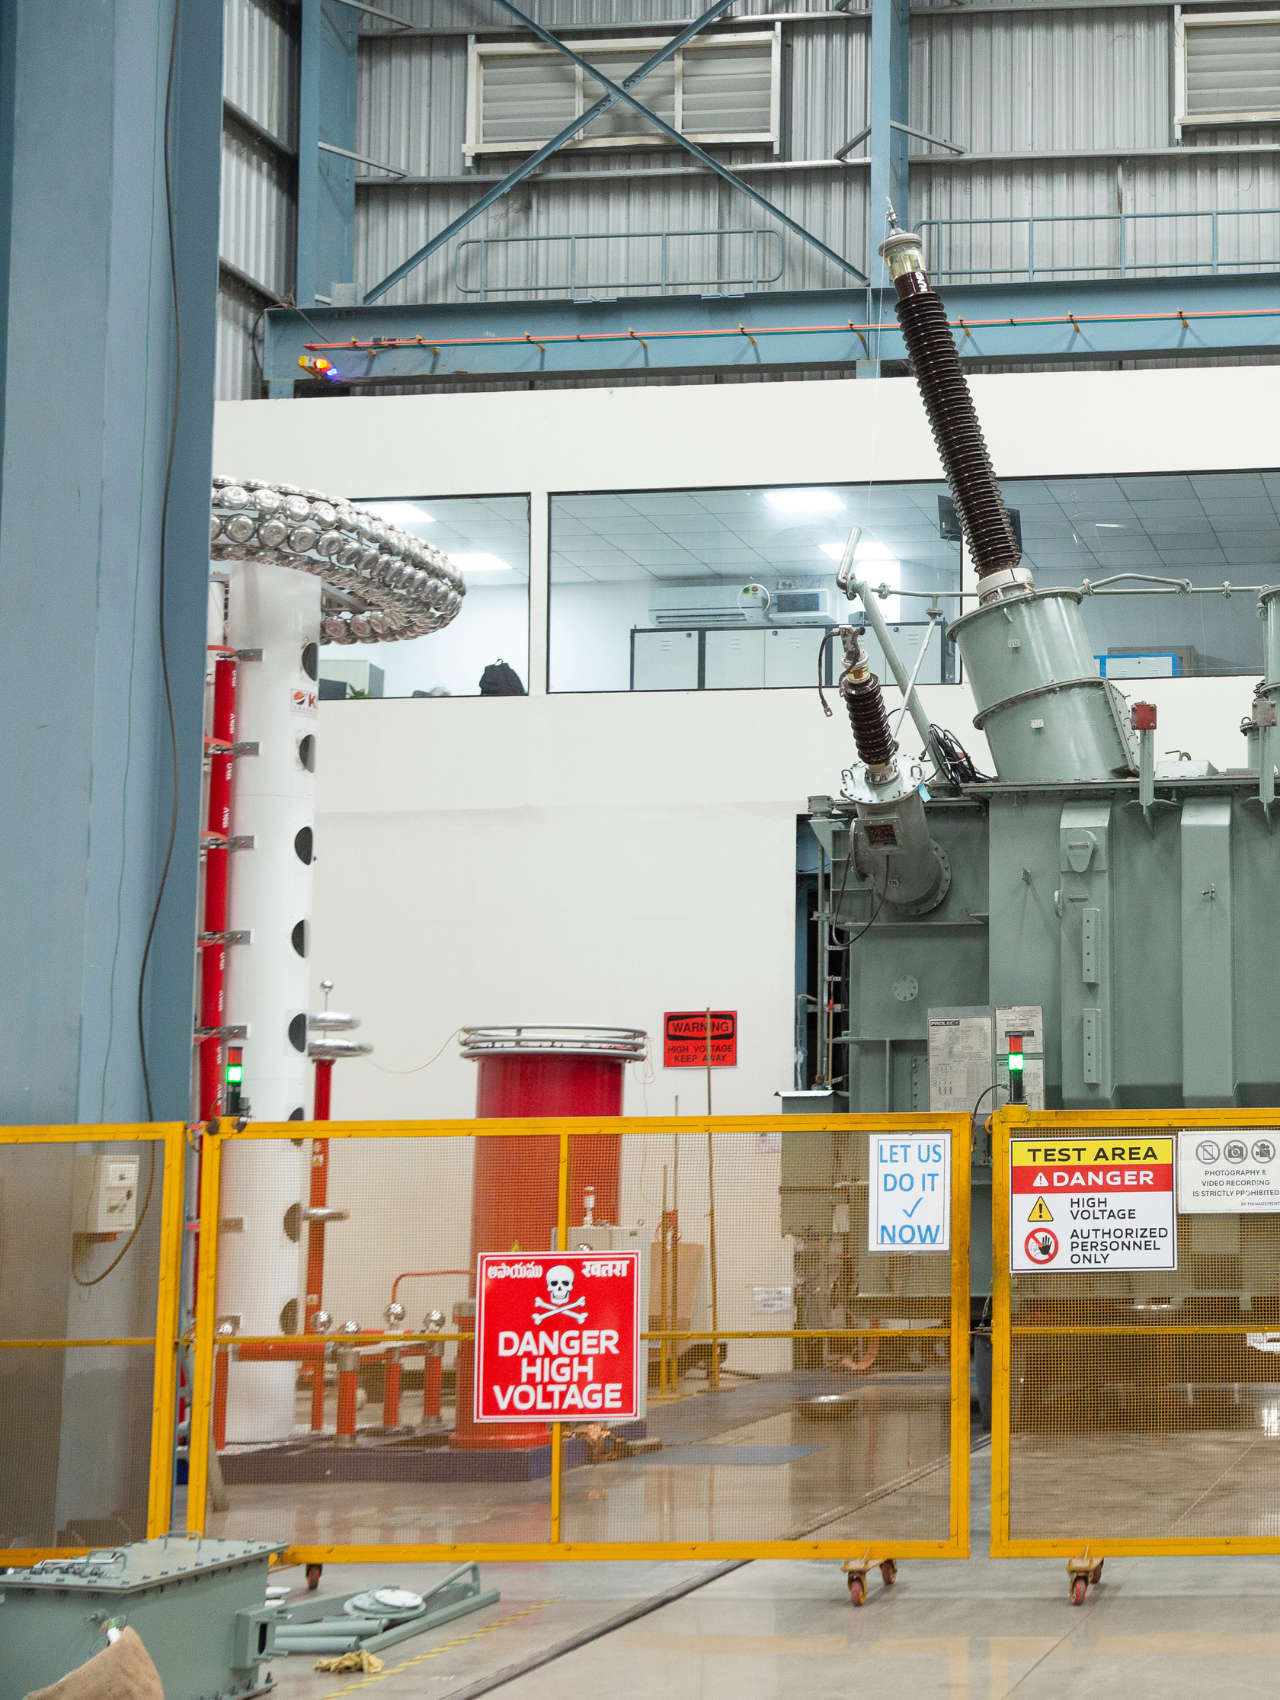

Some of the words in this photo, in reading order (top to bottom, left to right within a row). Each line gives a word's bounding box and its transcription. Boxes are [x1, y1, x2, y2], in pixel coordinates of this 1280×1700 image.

[672, 1021, 729, 1032] WARNNG
[667, 1045, 688, 1053] HIGH
[693, 1044, 733, 1053] VOTAGE
[674, 1054, 697, 1062] KEEP
[880, 1145, 911, 1163] LET
[918, 1144, 942, 1163] US
[1027, 1148, 1086, 1162] TEST
[1093, 1146, 1158, 1161] AREA
[883, 1173, 914, 1192] DO
[921, 1173, 939, 1192] IT
[1053, 1171, 1154, 1187] DANGER
[1070, 1197, 1107, 1208] HIGH
[1070, 1209, 1136, 1220] VOLTAGE
[881, 1224, 940, 1244] NOW
[1070, 1227, 1168, 1239] AUTHORIZED
[1070, 1240, 1160, 1252] PERSONNEL
[1070, 1253, 1110, 1264] ONLY
[487, 1261, 543, 1279] అపాయము
[581, 1259, 630, 1278] खतरा
[498, 1329, 619, 1356] DANGER
[521, 1357, 593, 1383] HIGH
[493, 1383, 622, 1410] VOLTAGE
